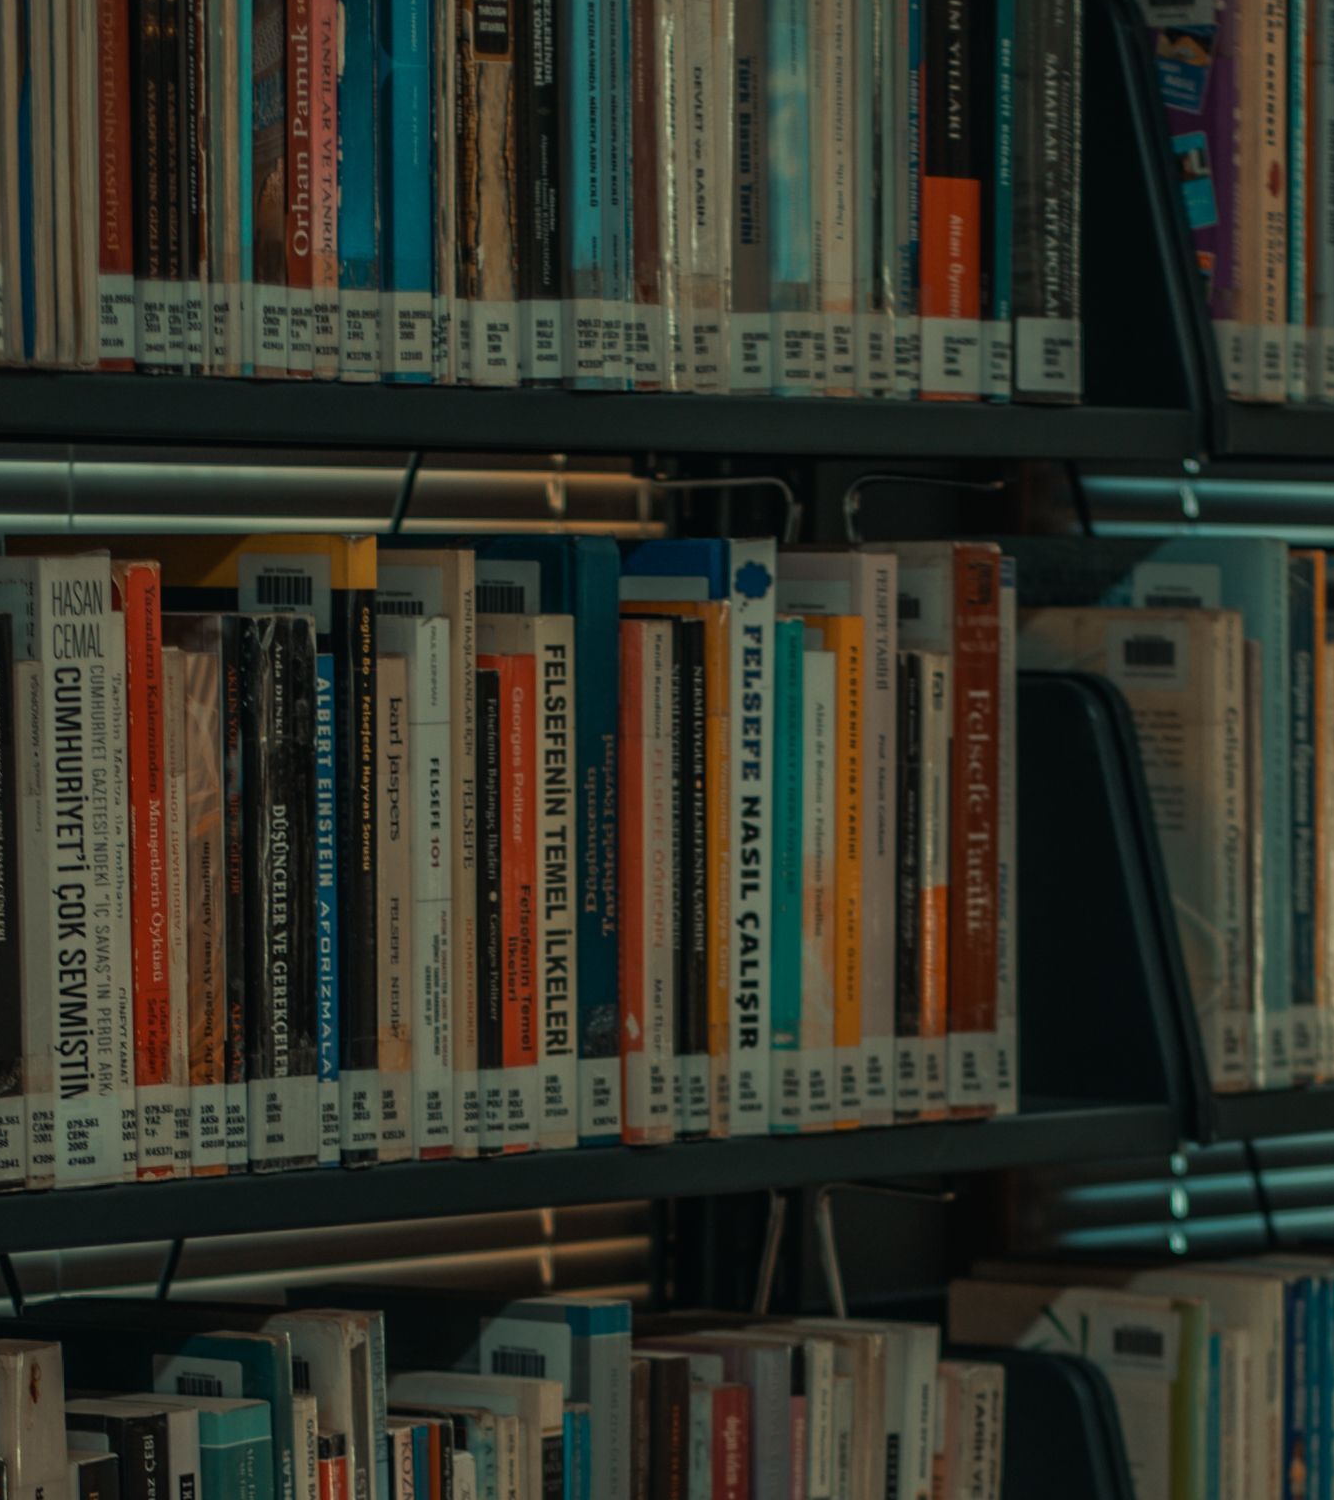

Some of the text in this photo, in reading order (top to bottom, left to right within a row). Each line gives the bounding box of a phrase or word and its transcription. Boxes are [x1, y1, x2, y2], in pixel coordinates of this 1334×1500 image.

[51, 581, 103, 615] HASAN
[52, 624, 103, 658] CEMAL
[89, 665, 108, 761] CUMHURİYET
[385, 697, 405, 841] karl jaspers
[430, 757, 441, 868] FELSEFE 101
[316, 677, 333, 1082] ALBERT EINSTEIN AFORİZMALA
[543, 644, 575, 1055] FELSEFENİN TEMEL İLKELERİ
[736, 626, 762, 1048] FELSEFE NASIL ÇALIŞIR
[51, 883, 87, 940] ÇOK
[269, 805, 289, 1076] DÜŞÜNCELER VE GEREKÇELER
[97, 1007, 112, 1055] PERDE
[98, 1061, 113, 1096] ARK
